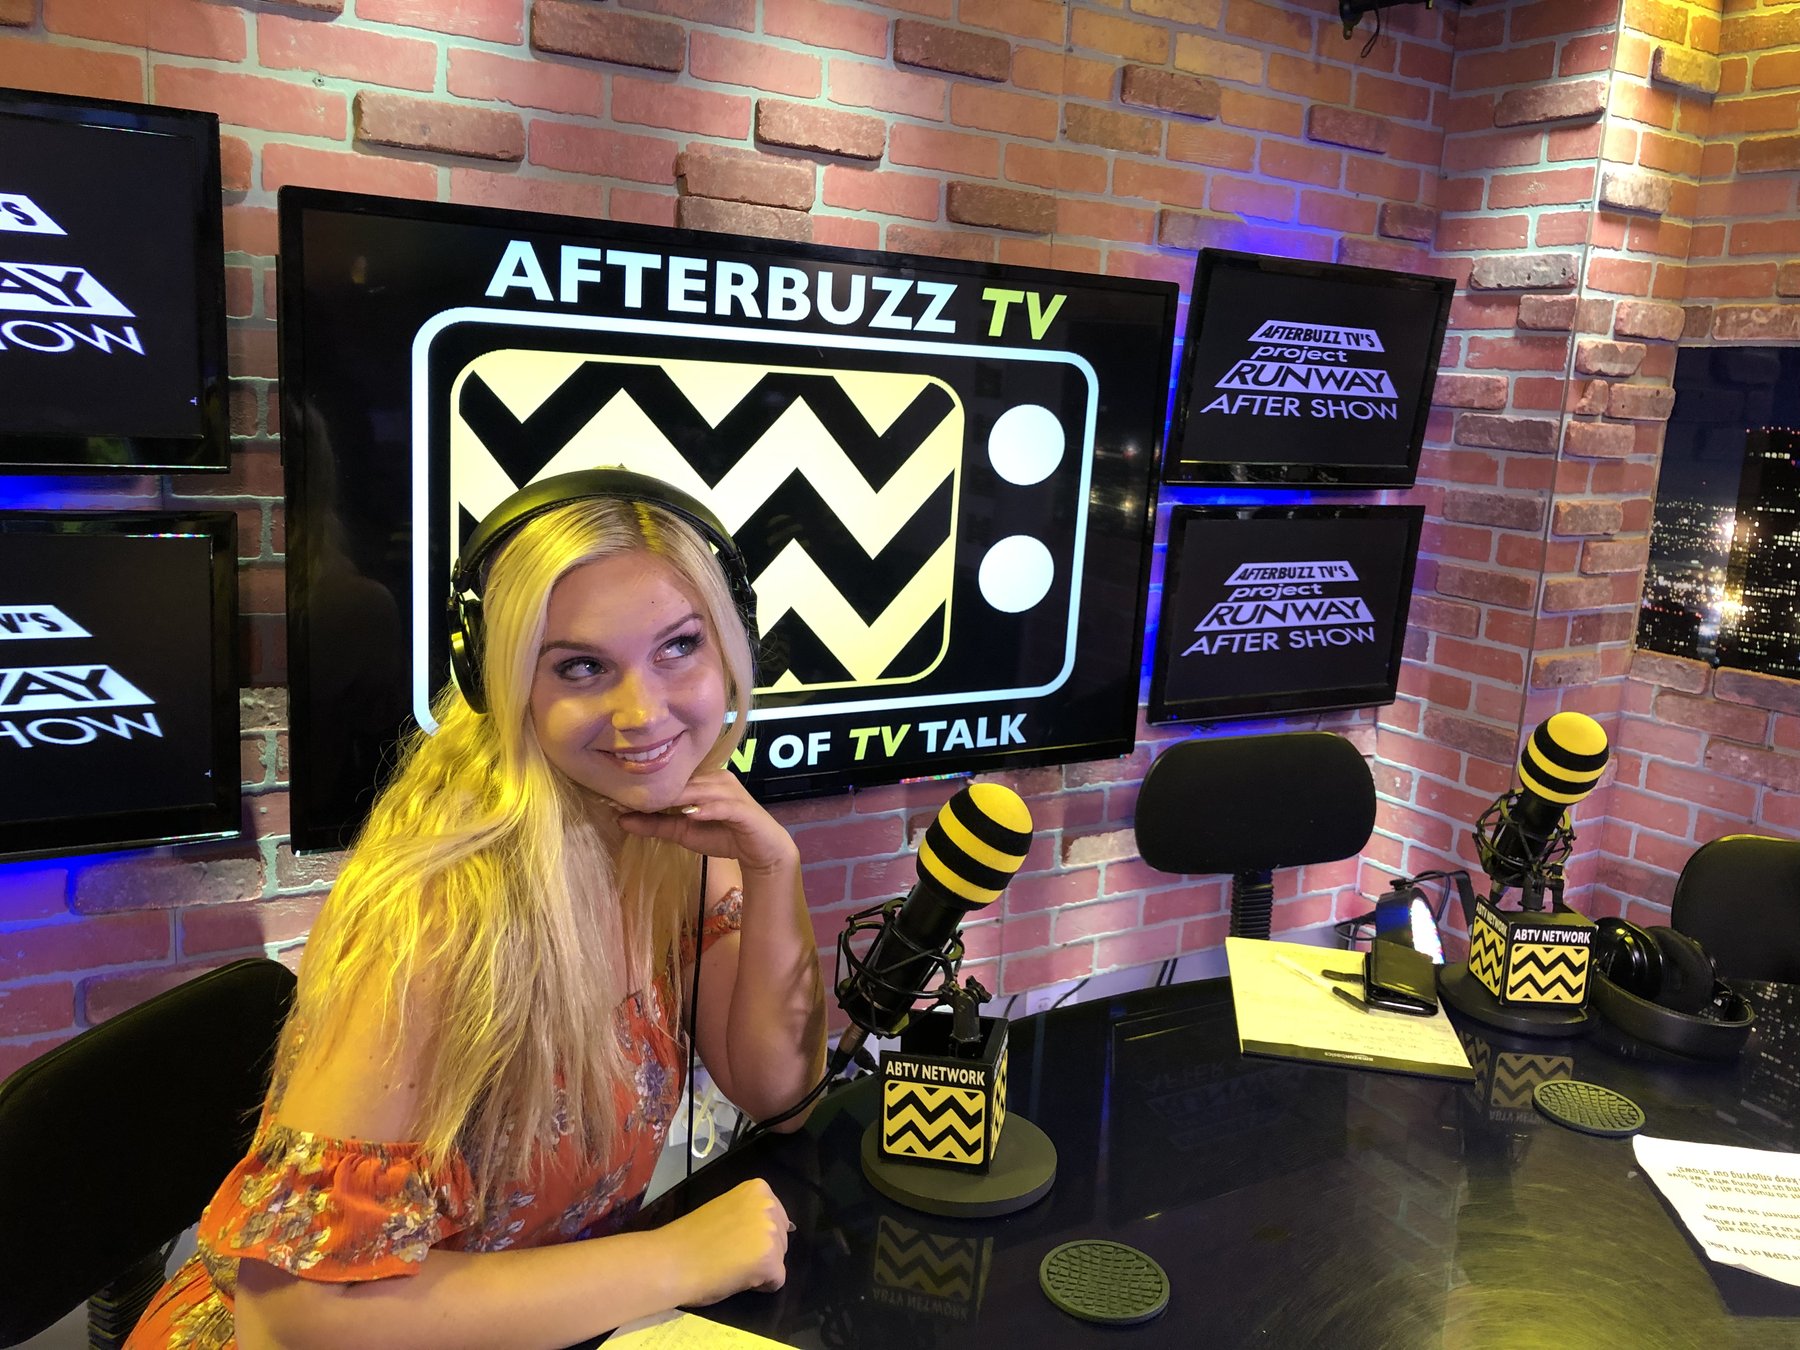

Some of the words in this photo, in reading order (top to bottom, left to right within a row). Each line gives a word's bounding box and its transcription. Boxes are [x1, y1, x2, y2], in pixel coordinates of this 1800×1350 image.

[485, 240, 959, 334] AFTERBUZZ
[981, 287, 1068, 341] TV
[0, 320, 146, 356] OW
[1258, 324, 1341, 344] AFTERBUZZ
[1345, 332, 1375, 347] TV'S
[1250, 345, 1348, 363] project
[1224, 362, 1386, 393] RUNWAY
[1200, 393, 1301, 417] AFTER
[1310, 399, 1397, 420] SHOW
[1234, 566, 1315, 581] AFTERBUZZ
[1317, 565, 1349, 579] TV'S
[1227, 584, 1323, 602] project
[1202, 600, 1361, 627] RUNWAY
[1180, 631, 1280, 657] AFTER
[1289, 626, 1375, 649] SHOW
[0, 669, 116, 706] AY
[768, 731, 832, 769] OF
[849, 723, 911, 761] TV
[918, 713, 1028, 753] TALK
[1513, 928, 1541, 942] ABTV
[1541, 930, 1591, 944] NETWORK
[885, 1060, 919, 1078] ABTV
[921, 1064, 986, 1086] NETWORK
